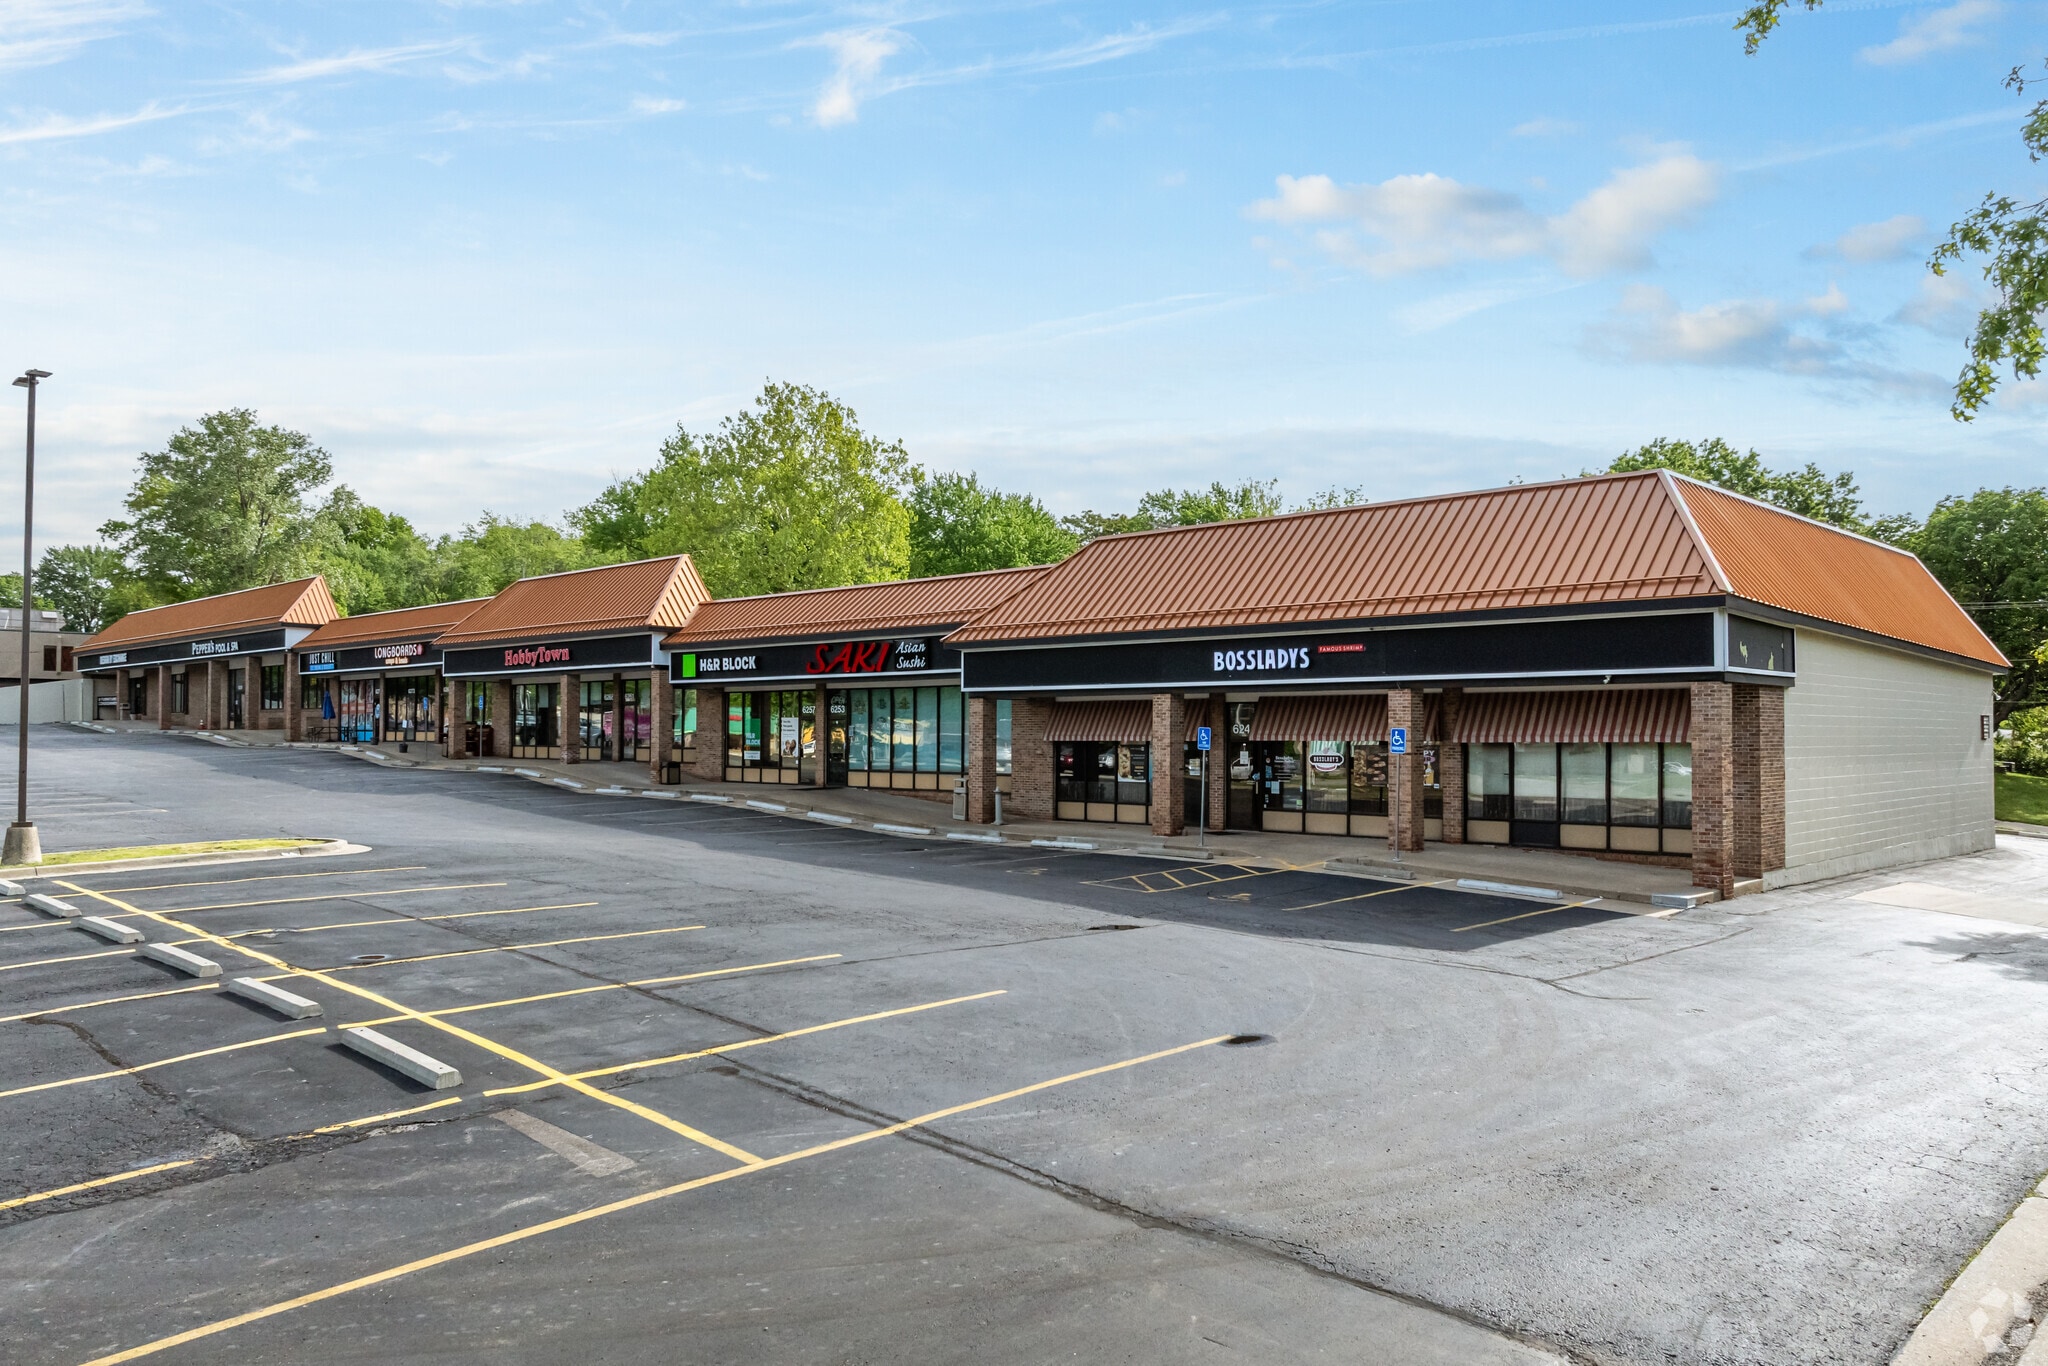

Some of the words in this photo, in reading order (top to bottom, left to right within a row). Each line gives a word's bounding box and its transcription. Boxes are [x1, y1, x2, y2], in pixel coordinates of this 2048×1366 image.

[374, 644, 417, 659] LONGBOARDS
[896, 641, 926, 654] Asian
[309, 652, 320, 665] JUST
[321, 651, 335, 663] CHILL
[504, 646, 570, 667] HobbyTown
[700, 657, 720, 672] H&R
[722, 655, 757, 671] BLOCK
[806, 642, 890, 674] SAKI
[896, 655, 926, 669] Sushi
[1213, 647, 1310, 671] BOSSLADYS
[830, 705, 846, 714] 6253
